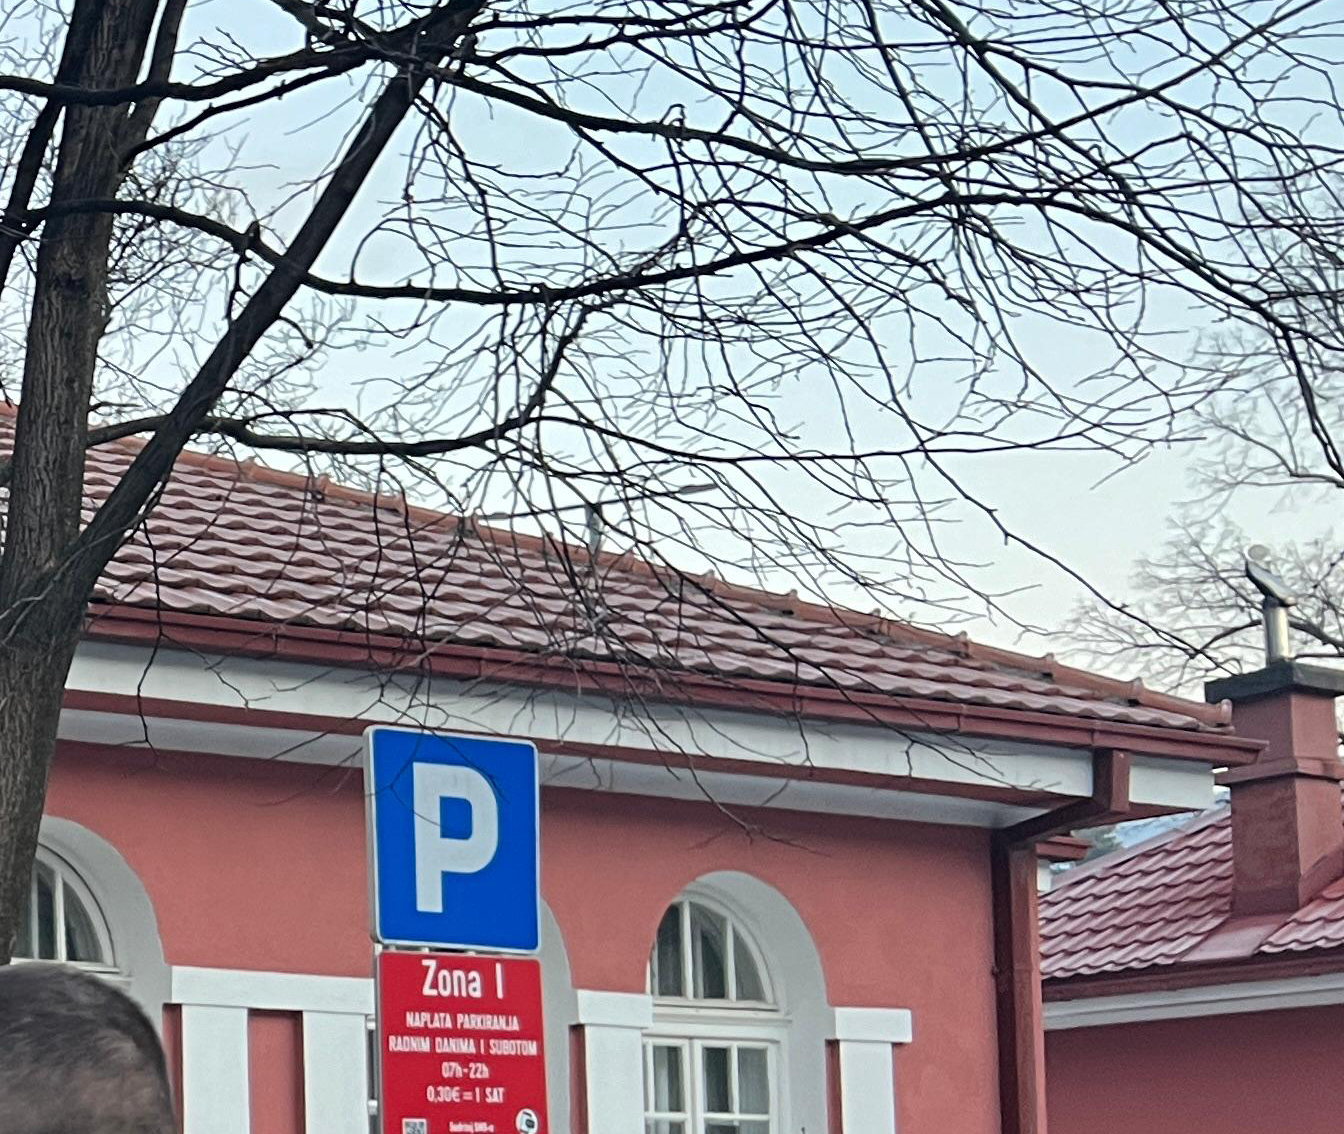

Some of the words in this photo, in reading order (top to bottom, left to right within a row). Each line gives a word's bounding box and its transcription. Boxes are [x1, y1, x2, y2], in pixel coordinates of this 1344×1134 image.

[413, 762, 498, 913] P
[421, 958, 482, 999] Zona
[406, 1011, 453, 1029] NAPLATA
[457, 1012, 520, 1032] PARKIRANJA
[388, 1035, 430, 1052] RADNIM
[435, 1036, 476, 1055] DANIMA
[489, 1039, 538, 1056] SUBOTOM
[485, 1087, 505, 1104] SAT
